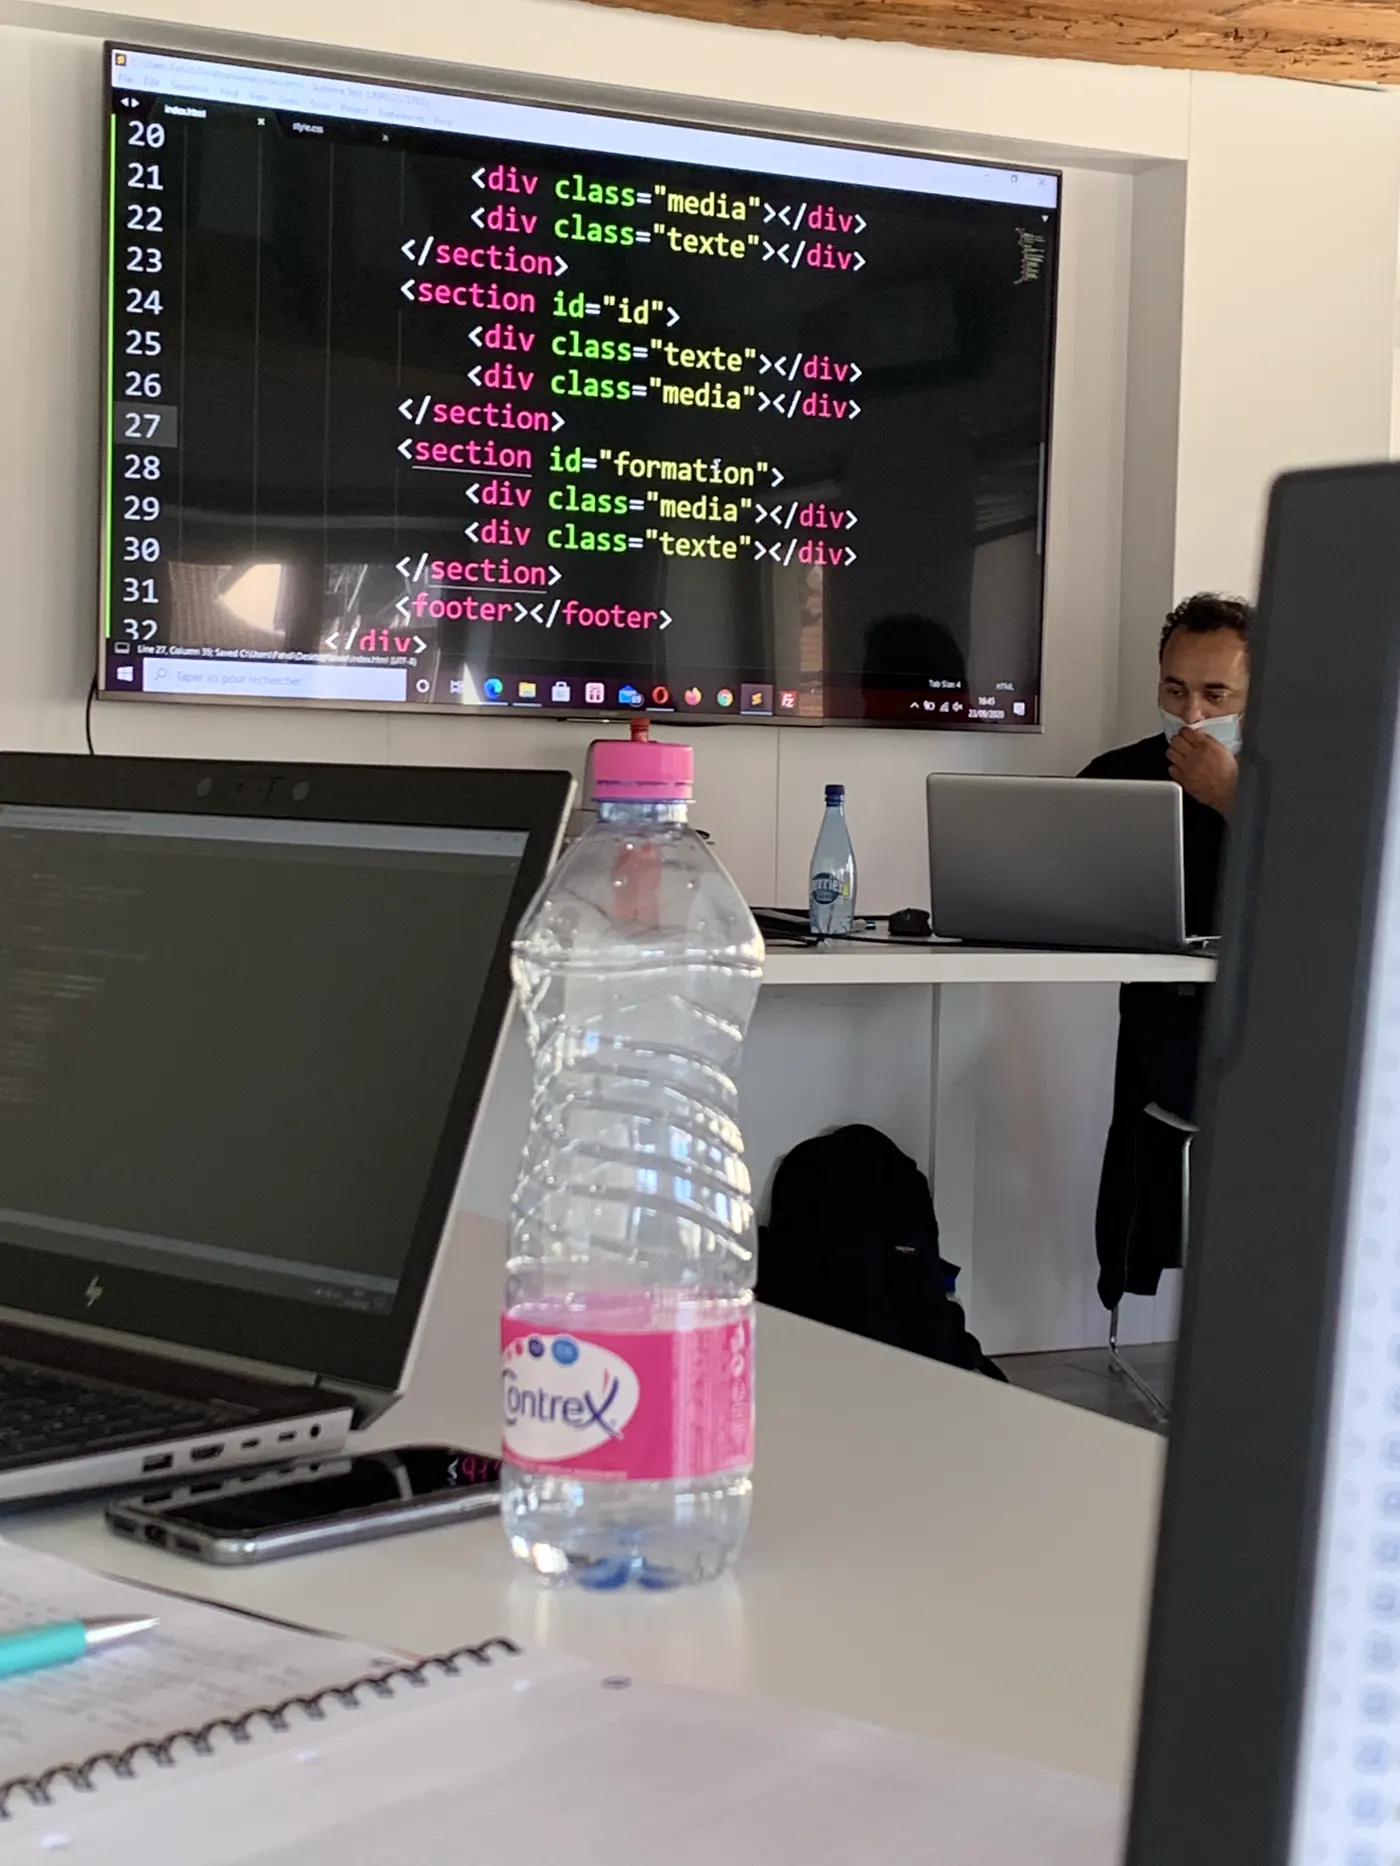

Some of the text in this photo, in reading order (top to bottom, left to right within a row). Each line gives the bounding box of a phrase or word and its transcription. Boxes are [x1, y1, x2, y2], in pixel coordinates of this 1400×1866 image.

[127, 120, 165, 149] 20
[471, 164, 538, 196] <div
[127, 163, 163, 191] 21
[470, 204, 537, 235] <div
[126, 204, 569, 280] 22 </section>
[126, 246, 681, 327] 23 <section id="id">
[125, 288, 163, 315] 24
[468, 323, 535, 353] <div
[125, 330, 162, 356] 25
[467, 362, 535, 392] <div
[124, 371, 566, 433] 26 </section>
[124, 413, 785, 488] 27 <section id="formation">
[124, 454, 161, 480] 28
[465, 480, 532, 508] <div
[123, 495, 160, 521] 29
[464, 518, 531, 546] <div
[122, 577, 159, 604] 31
[123, 537, 562, 587] 30 </section>
[122, 618, 428, 654] 32 </div>
[137, 645, 154, 654] Line
[169, 646, 201, 656] Column
[176, 671, 205, 684] Taper
[221, 674, 247, 686] pour
[249, 674, 302, 687] rechercher
